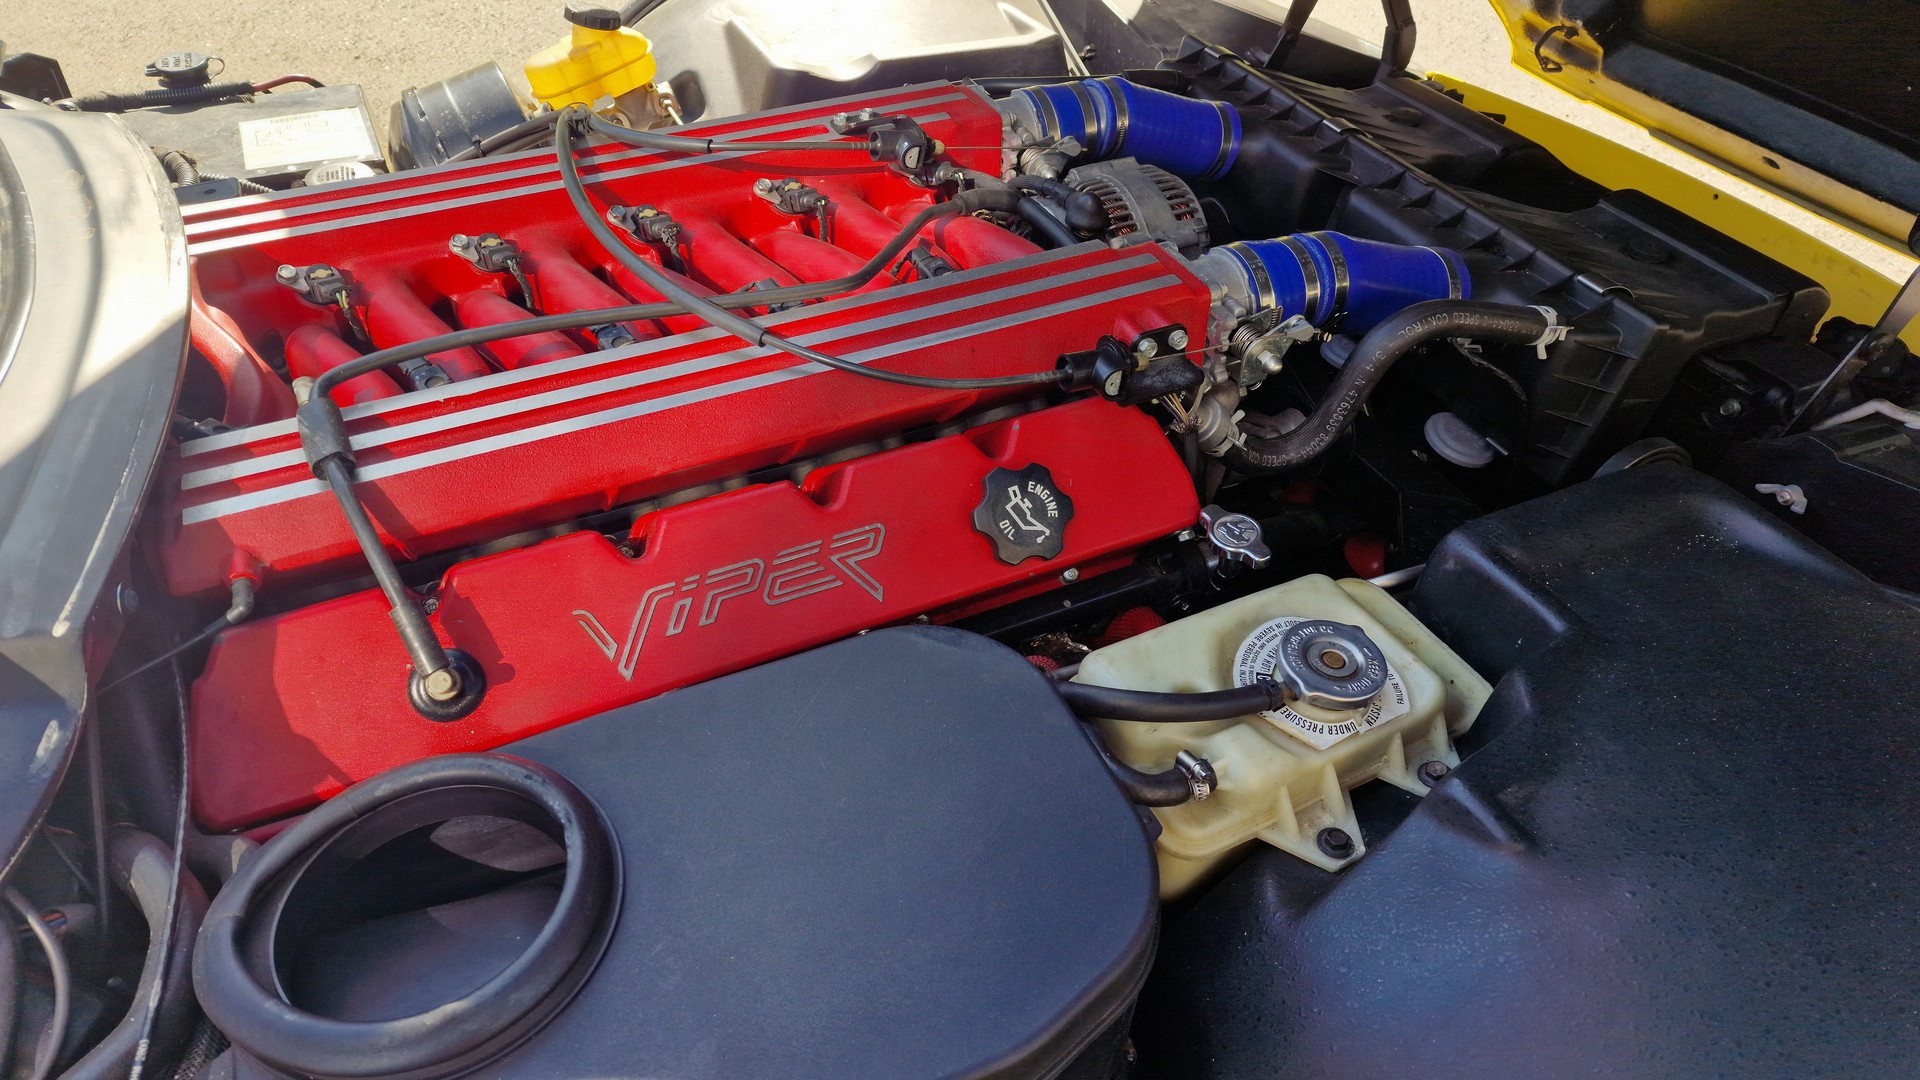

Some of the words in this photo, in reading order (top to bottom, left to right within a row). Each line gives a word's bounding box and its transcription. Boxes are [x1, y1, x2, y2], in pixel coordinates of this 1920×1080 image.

[1398, 313, 1449, 338] CONTROL
[1262, 454, 1287, 467] SPEED
[1027, 481, 1059, 518] ENGINE
[999, 519, 1016, 541] OIL
[1254, 625, 1276, 643] SEVERE
[1274, 622, 1283, 630] IN
[1239, 640, 1258, 668] PERSONAL
[1368, 658, 1379, 679] KEEP
[1391, 682, 1405, 705] FAILURE
[1280, 707, 1324, 734] PRESSURE
[1327, 720, 1358, 736] UNDER
